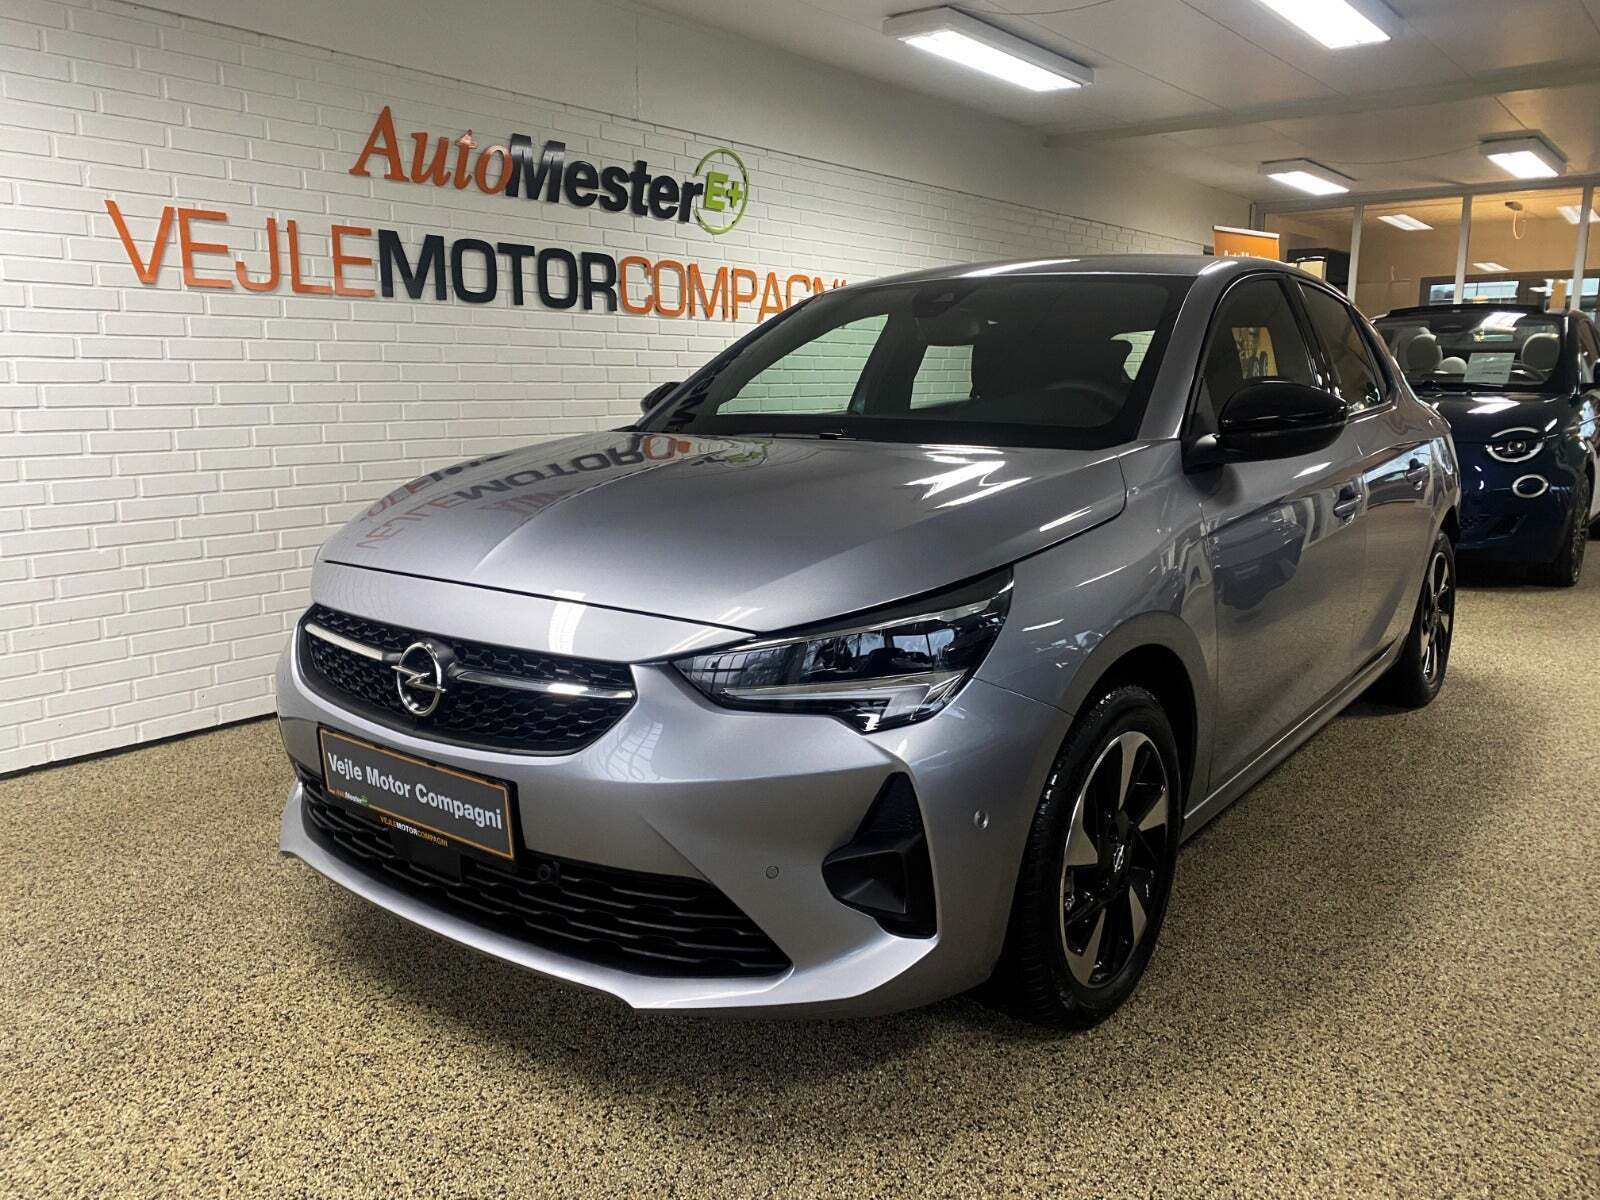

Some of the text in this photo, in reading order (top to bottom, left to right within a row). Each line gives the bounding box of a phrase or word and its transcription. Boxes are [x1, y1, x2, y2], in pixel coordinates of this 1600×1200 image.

[328, 752, 502, 829] Vejle Motor Compagni
